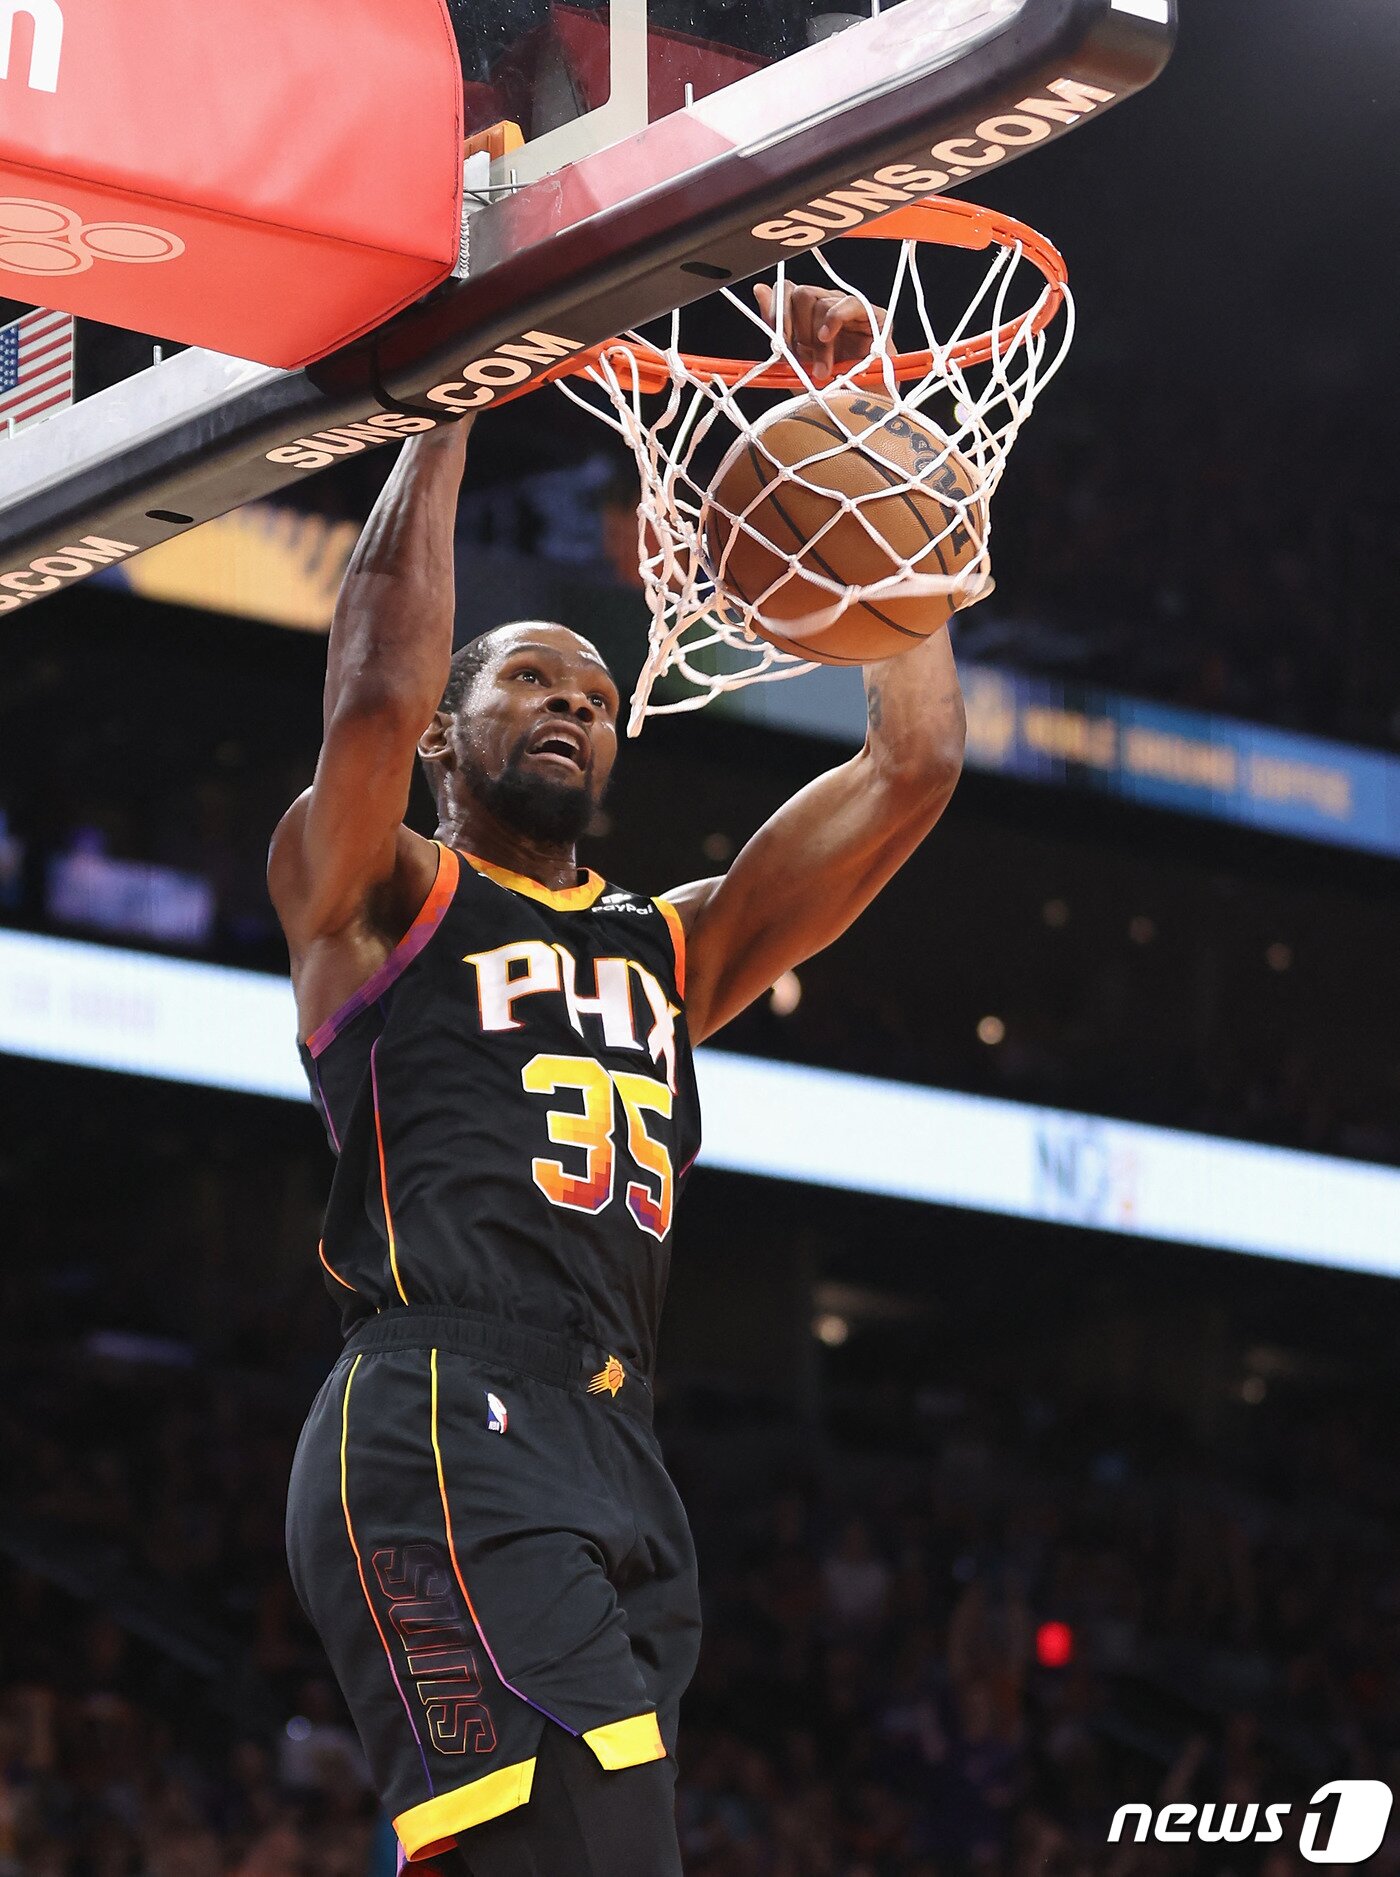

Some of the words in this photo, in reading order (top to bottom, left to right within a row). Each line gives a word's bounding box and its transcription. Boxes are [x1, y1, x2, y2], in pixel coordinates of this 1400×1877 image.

[751, 78, 1116, 247] SUNS.COM
[265, 330, 586, 469] SUNS.COM
[591, 902, 654, 915] PayPal
[462, 940, 682, 1096] PHX
[521, 1053, 673, 1243] 35
[371, 1544, 497, 1755] SUNS
